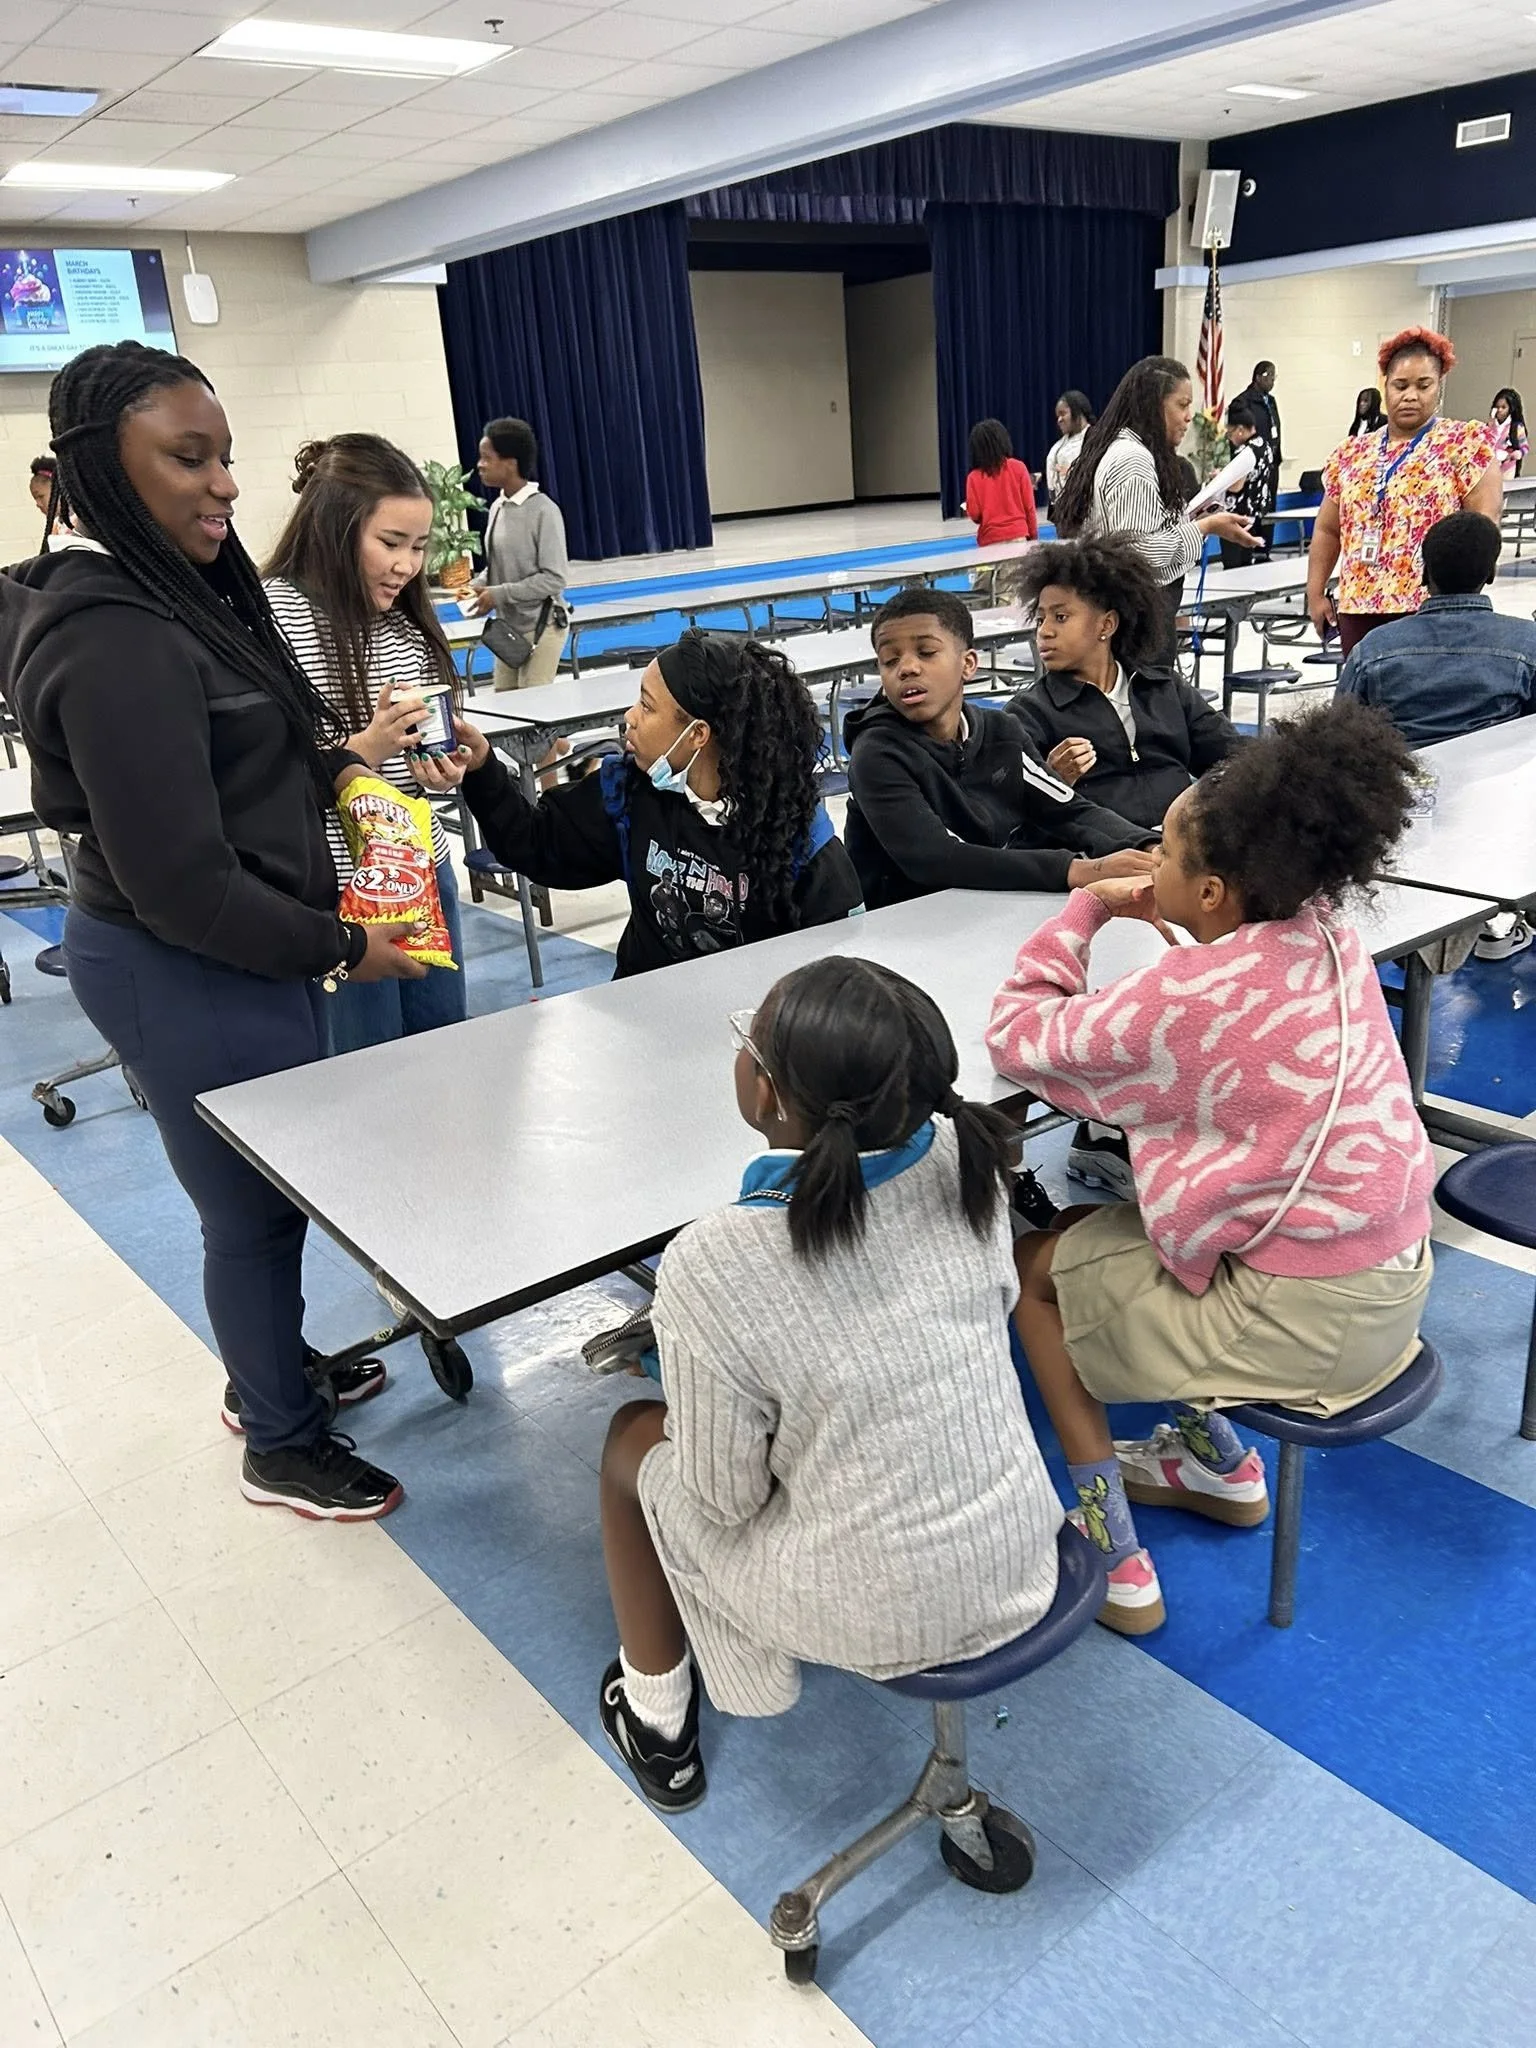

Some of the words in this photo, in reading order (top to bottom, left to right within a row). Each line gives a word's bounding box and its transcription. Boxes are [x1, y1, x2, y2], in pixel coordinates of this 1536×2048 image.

[67, 267, 101, 275] BIRTHDAYS
[385, 879, 418, 896] ONLY
[685, 875, 706, 892] THE
